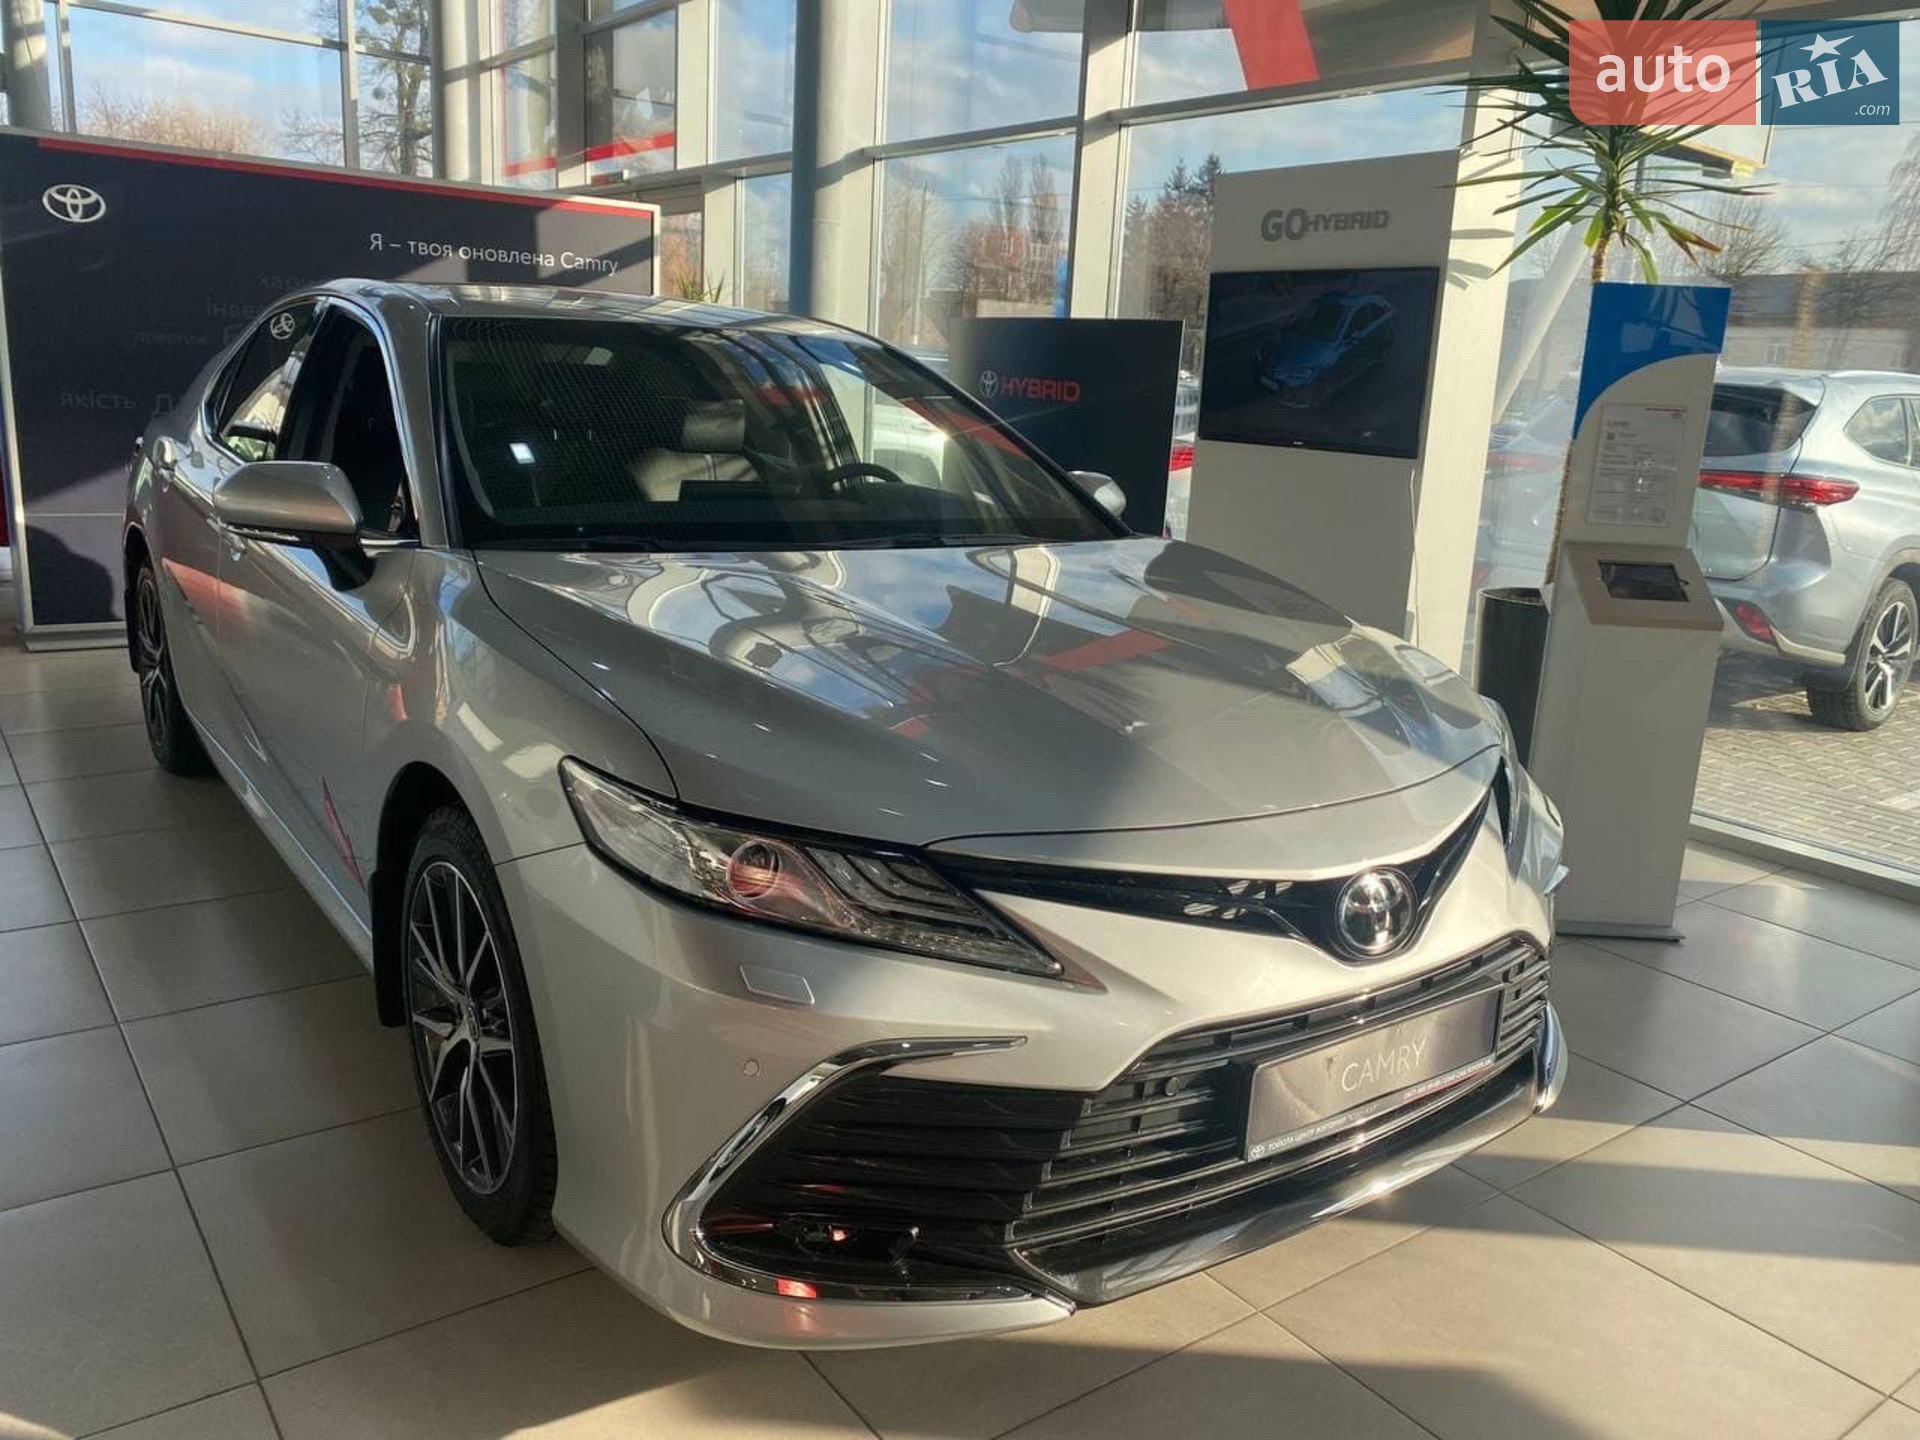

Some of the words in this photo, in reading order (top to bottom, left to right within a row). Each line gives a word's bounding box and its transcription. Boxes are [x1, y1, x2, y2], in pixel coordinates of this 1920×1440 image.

[369, 233, 383, 251] Я
[407, 240, 453, 257] твоя
[458, 246, 554, 267] оновлена
[560, 252, 618, 276] Camry
[1001, 376, 1081, 402] HYBRID
[1341, 1038, 1427, 1092] CAMRY
